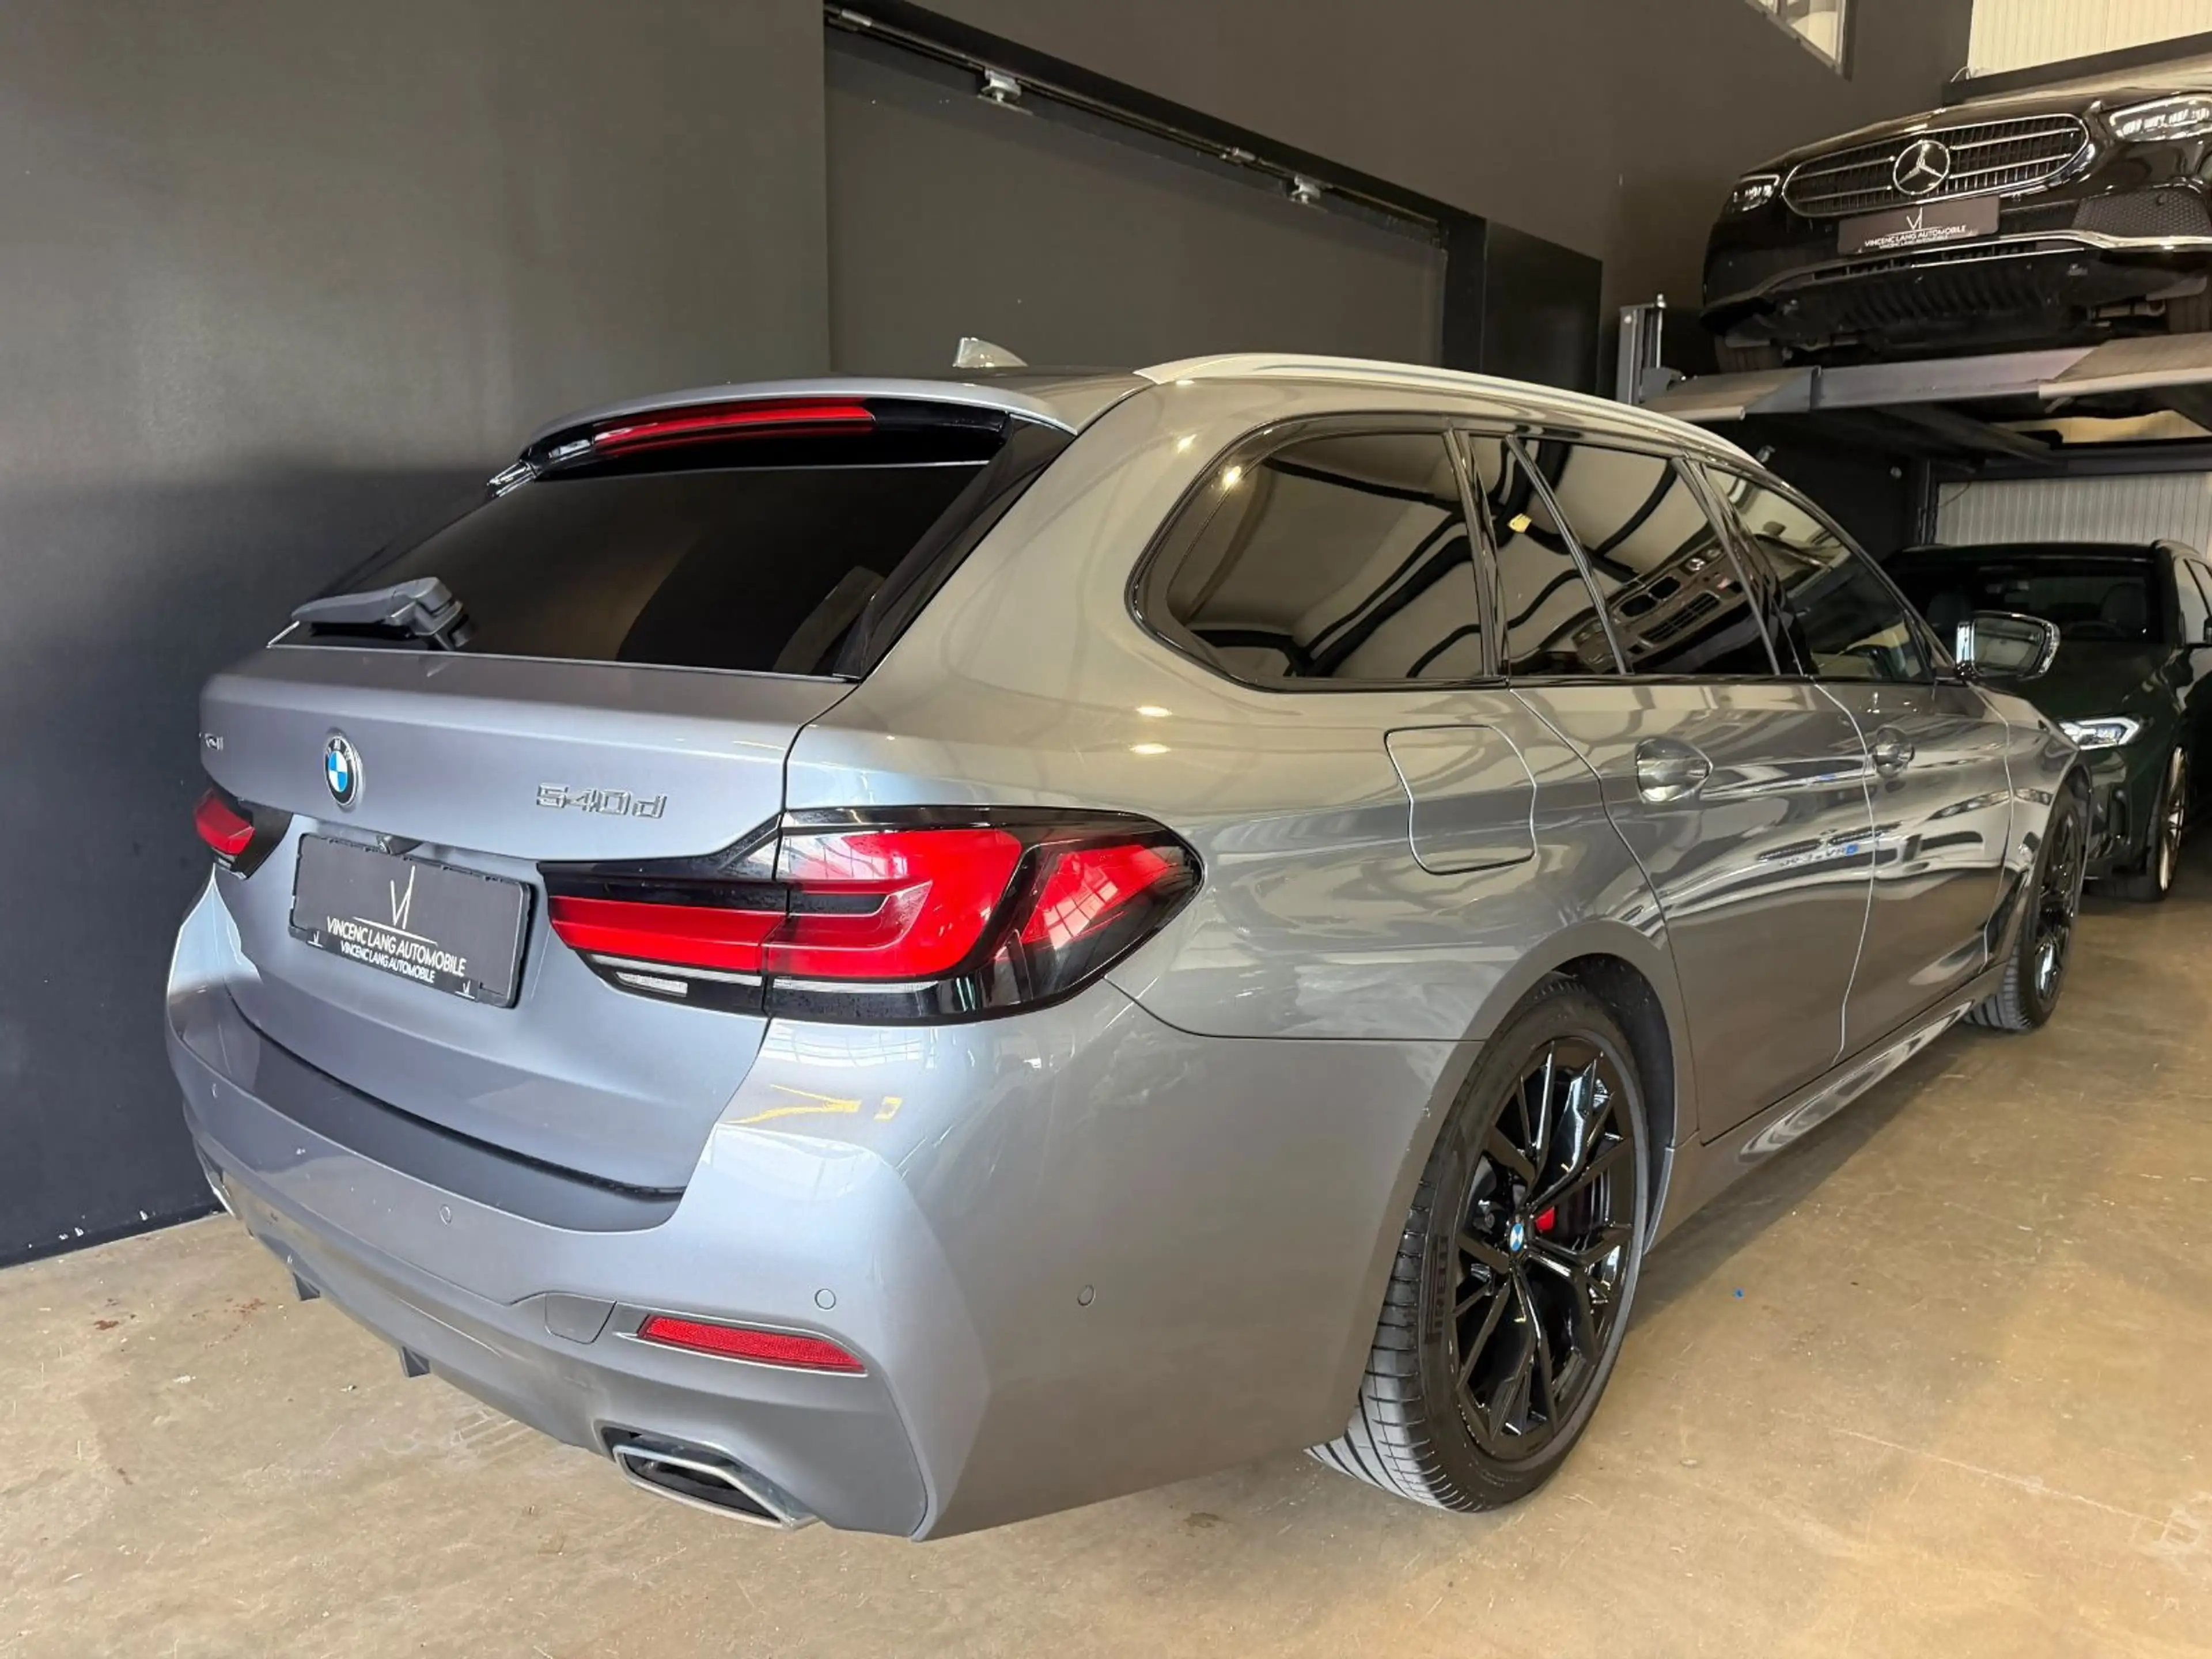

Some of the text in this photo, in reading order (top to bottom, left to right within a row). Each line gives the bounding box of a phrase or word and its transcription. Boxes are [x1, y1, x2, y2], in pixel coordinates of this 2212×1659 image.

[536, 782, 667, 819] 540d
[327, 916, 468, 978] VINCENC LANG AUTOMOBILE
[341, 940, 370, 961] VINCENC
[388, 956, 436, 984] AUTOMOBILE
